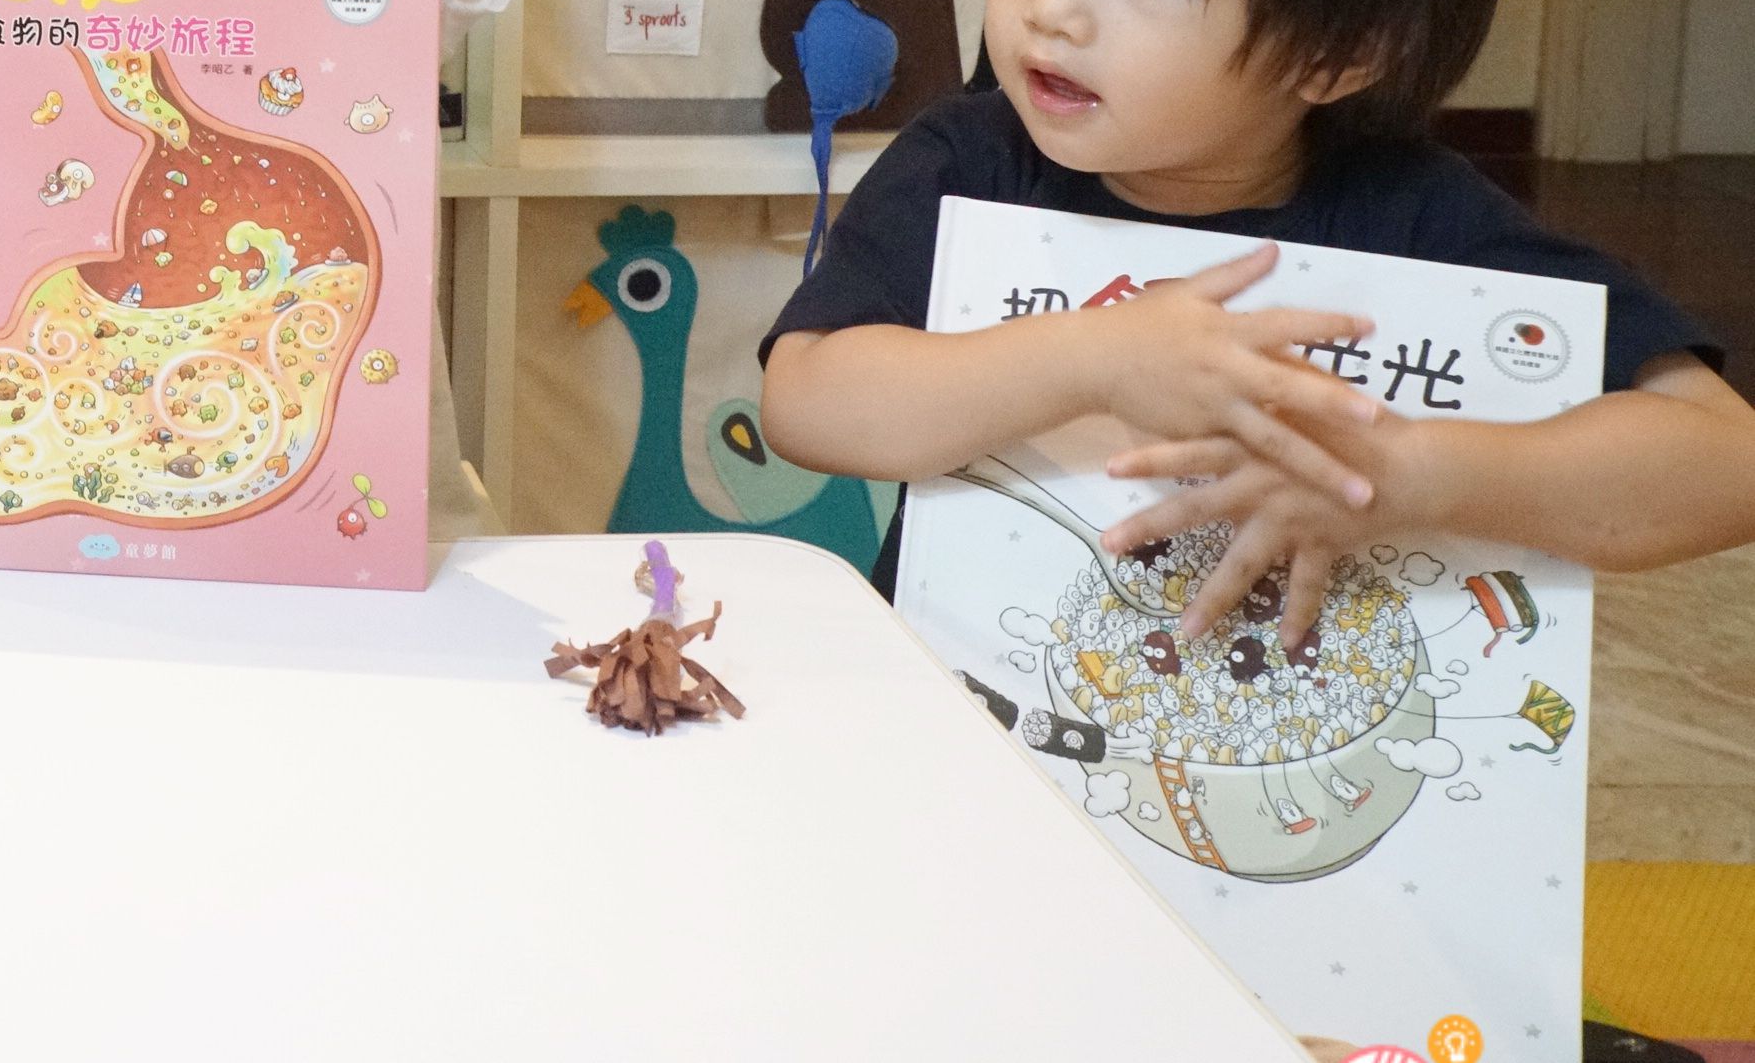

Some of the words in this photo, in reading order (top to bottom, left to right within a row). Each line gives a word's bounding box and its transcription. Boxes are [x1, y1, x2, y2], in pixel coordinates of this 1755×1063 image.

[638, 4, 687, 40] sprouts
[200, 63, 235, 76] 李昭乙
